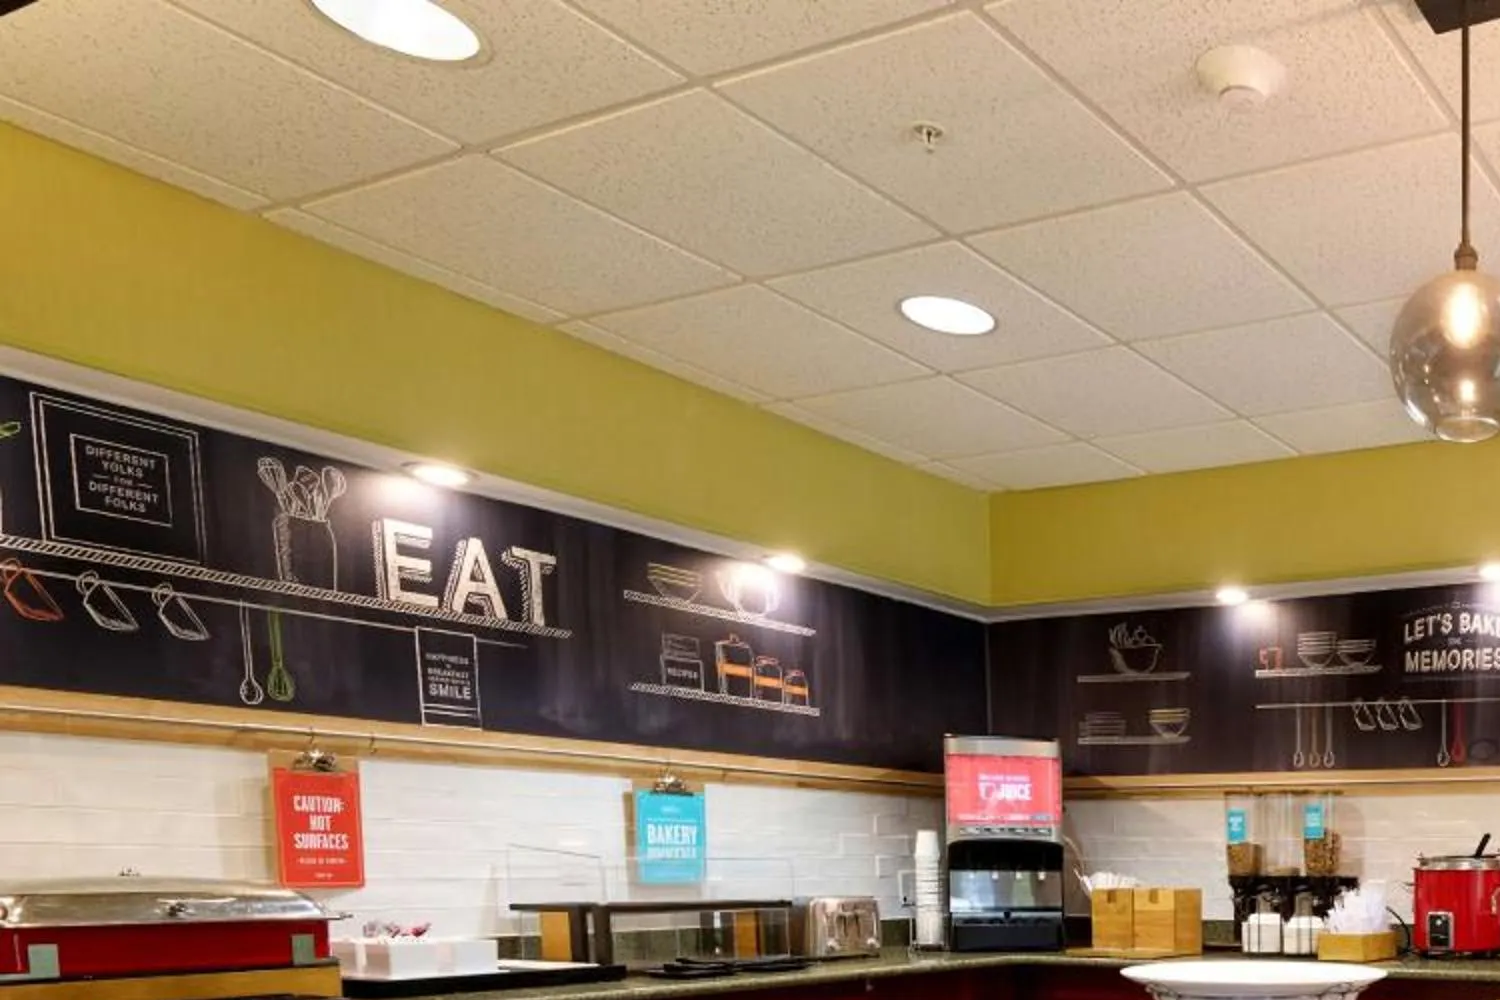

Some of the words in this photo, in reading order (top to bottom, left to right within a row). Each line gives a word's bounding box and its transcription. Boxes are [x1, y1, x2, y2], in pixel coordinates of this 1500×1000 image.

[85, 444, 156, 470] DIFFERENT
[101, 460, 143, 478] YOLKS
[88, 481, 159, 503] DIFFERENT
[104, 495, 146, 513] FOLKS
[372, 518, 557, 627] EAT
[1404, 612, 1453, 644] LET'S
[428, 683, 471, 700] SMILE
[293, 832, 349, 849] SURFACES
[647, 823, 697, 845] BAKERY
